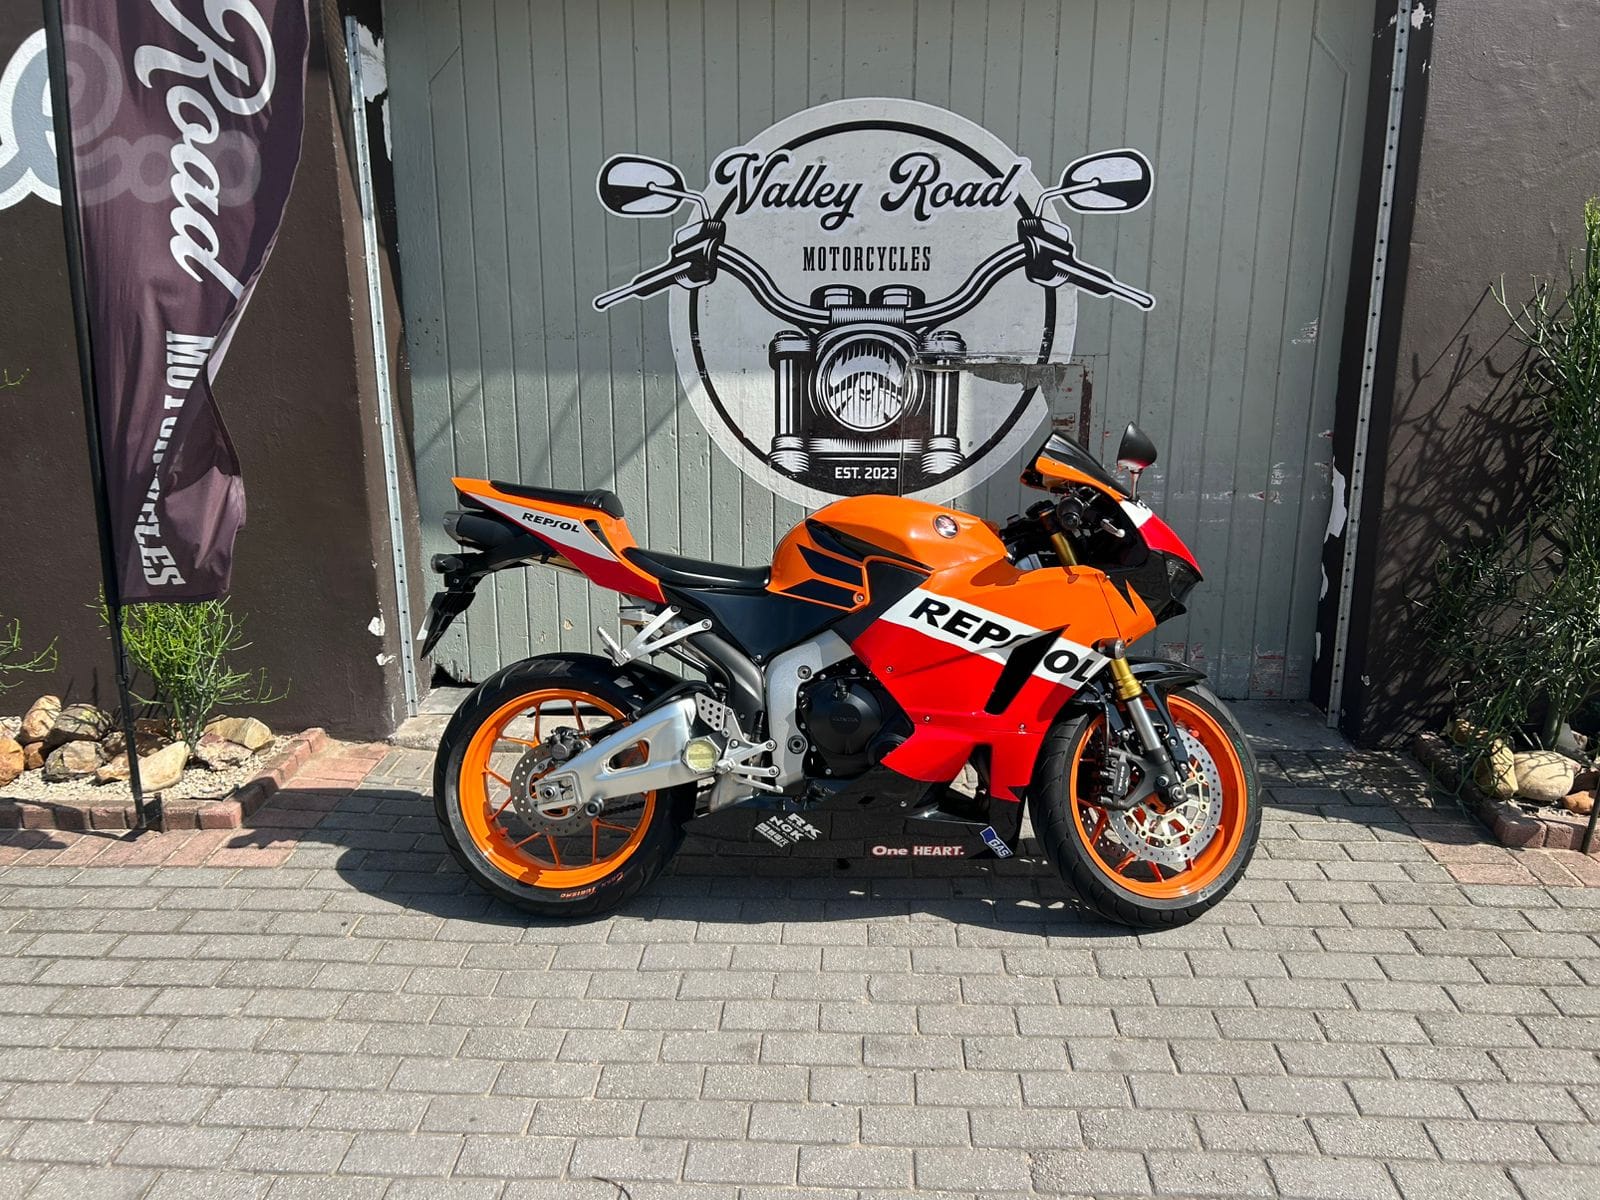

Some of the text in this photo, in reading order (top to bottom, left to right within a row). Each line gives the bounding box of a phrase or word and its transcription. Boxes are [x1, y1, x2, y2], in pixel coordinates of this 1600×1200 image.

[134, 0, 276, 299] Road
[714, 151, 1023, 231] Valley Road
[802, 246, 932, 272] MOTORCYCLES
[834, 466, 898, 480] EST. 2023
[521, 511, 580, 533] REPSOL
[768, 815, 805, 841] NGK
[872, 845, 965, 856] One HEART.
